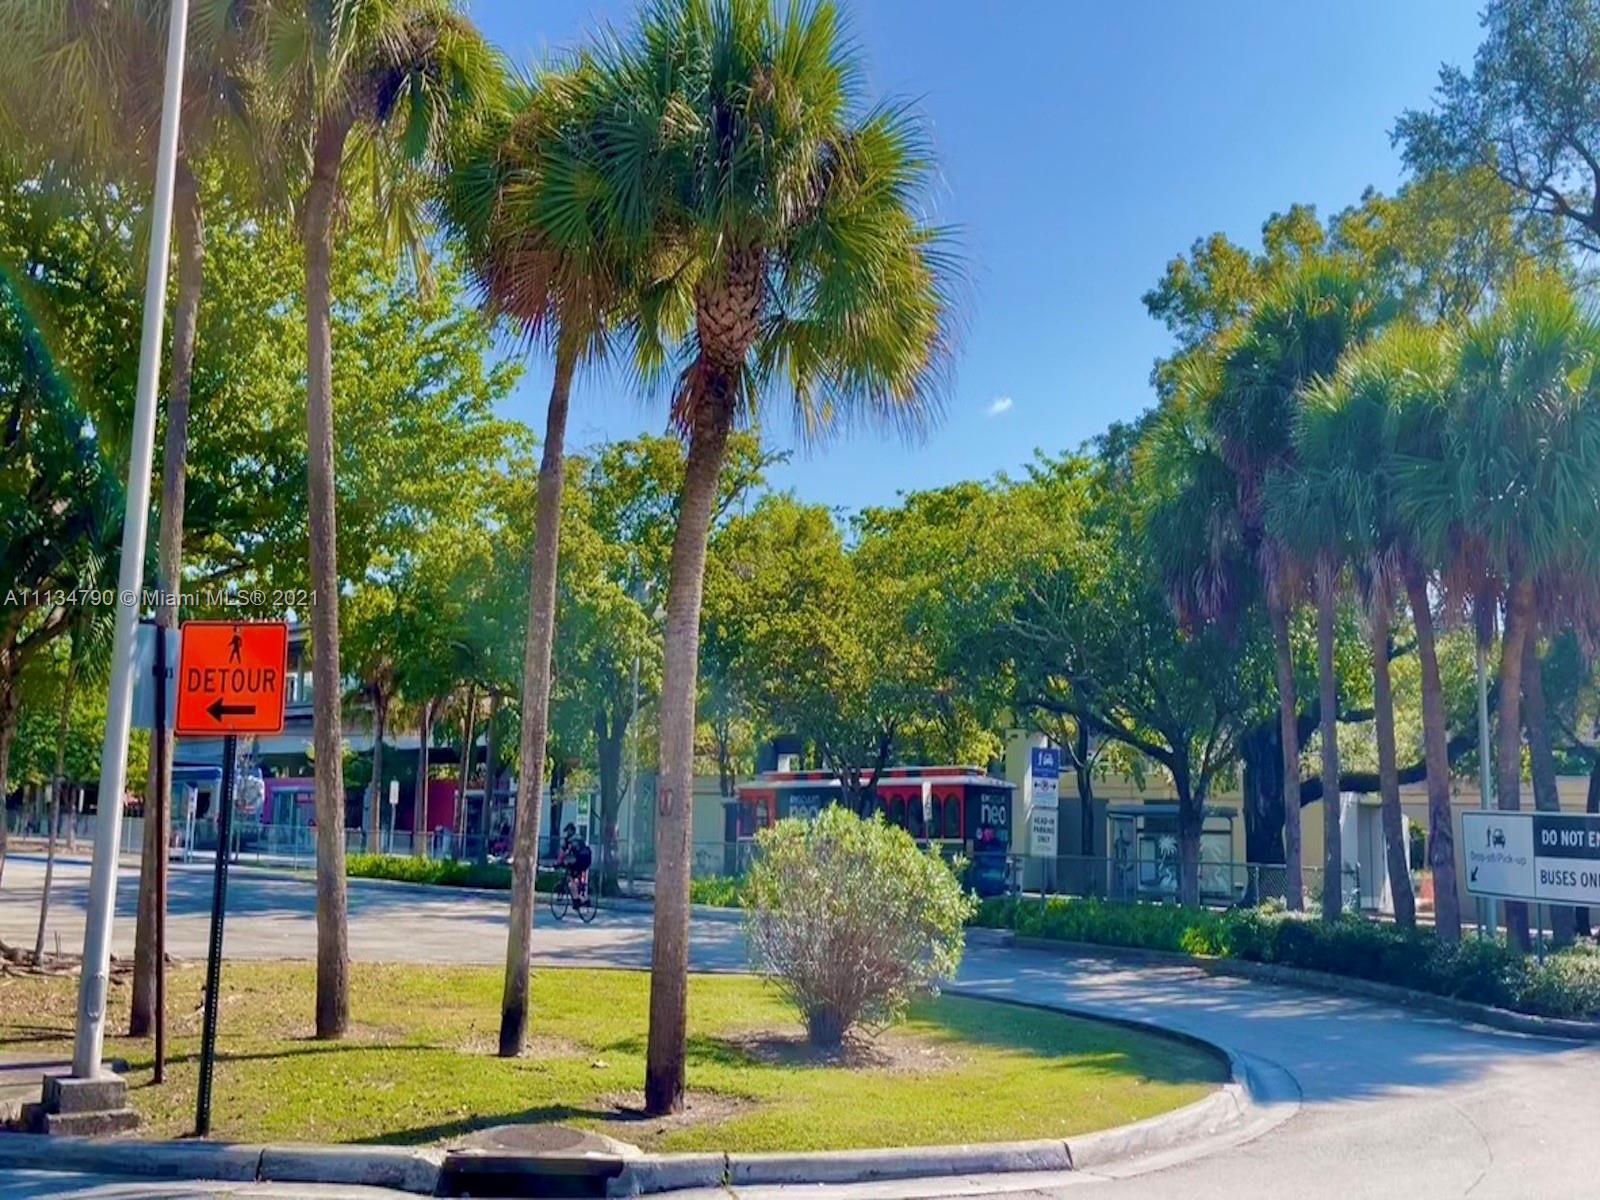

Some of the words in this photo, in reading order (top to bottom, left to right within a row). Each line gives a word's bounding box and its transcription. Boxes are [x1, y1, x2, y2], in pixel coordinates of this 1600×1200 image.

[186, 668, 276, 694] DETOUR
[980, 804, 1007, 825] neo
[1541, 828, 1558, 846] DO
[1561, 829, 1585, 847] NOT
[1540, 868, 1577, 888] BUSES
